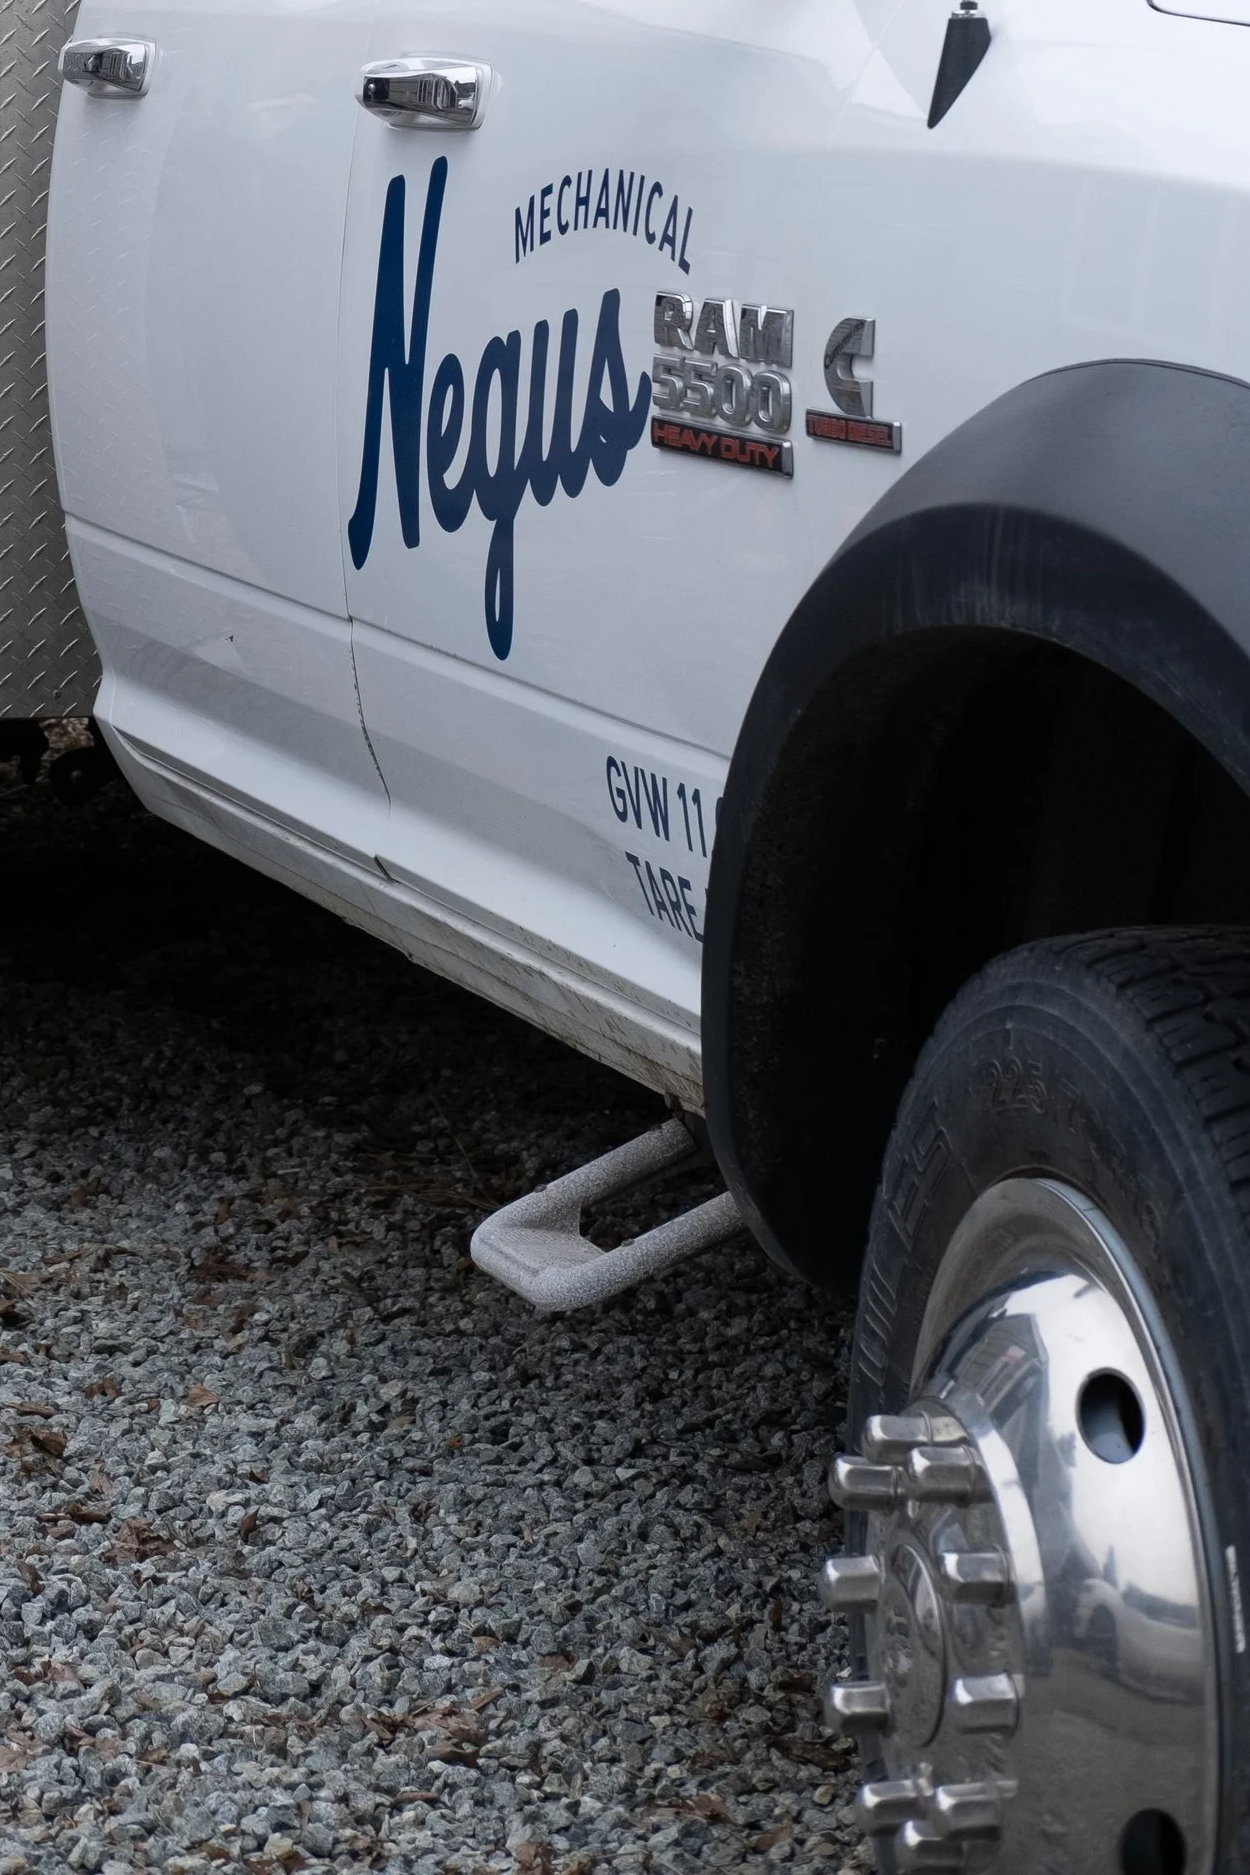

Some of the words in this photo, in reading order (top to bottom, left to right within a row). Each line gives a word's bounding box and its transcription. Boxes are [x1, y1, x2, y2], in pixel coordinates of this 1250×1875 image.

[514, 167, 693, 276] MECHANICAL
[653, 291, 794, 368] RAM
[348, 155, 651, 661] Negus
[652, 353, 792, 435] 5500
[806, 413, 846, 439] TURBO
[847, 418, 892, 447] DIESEL
[654, 421, 717, 454] HEAVY
[720, 437, 780, 469] DUTY
[606, 755, 670, 842] GVW
[676, 782, 723, 858] 11
[624, 850, 704, 944] TARE
